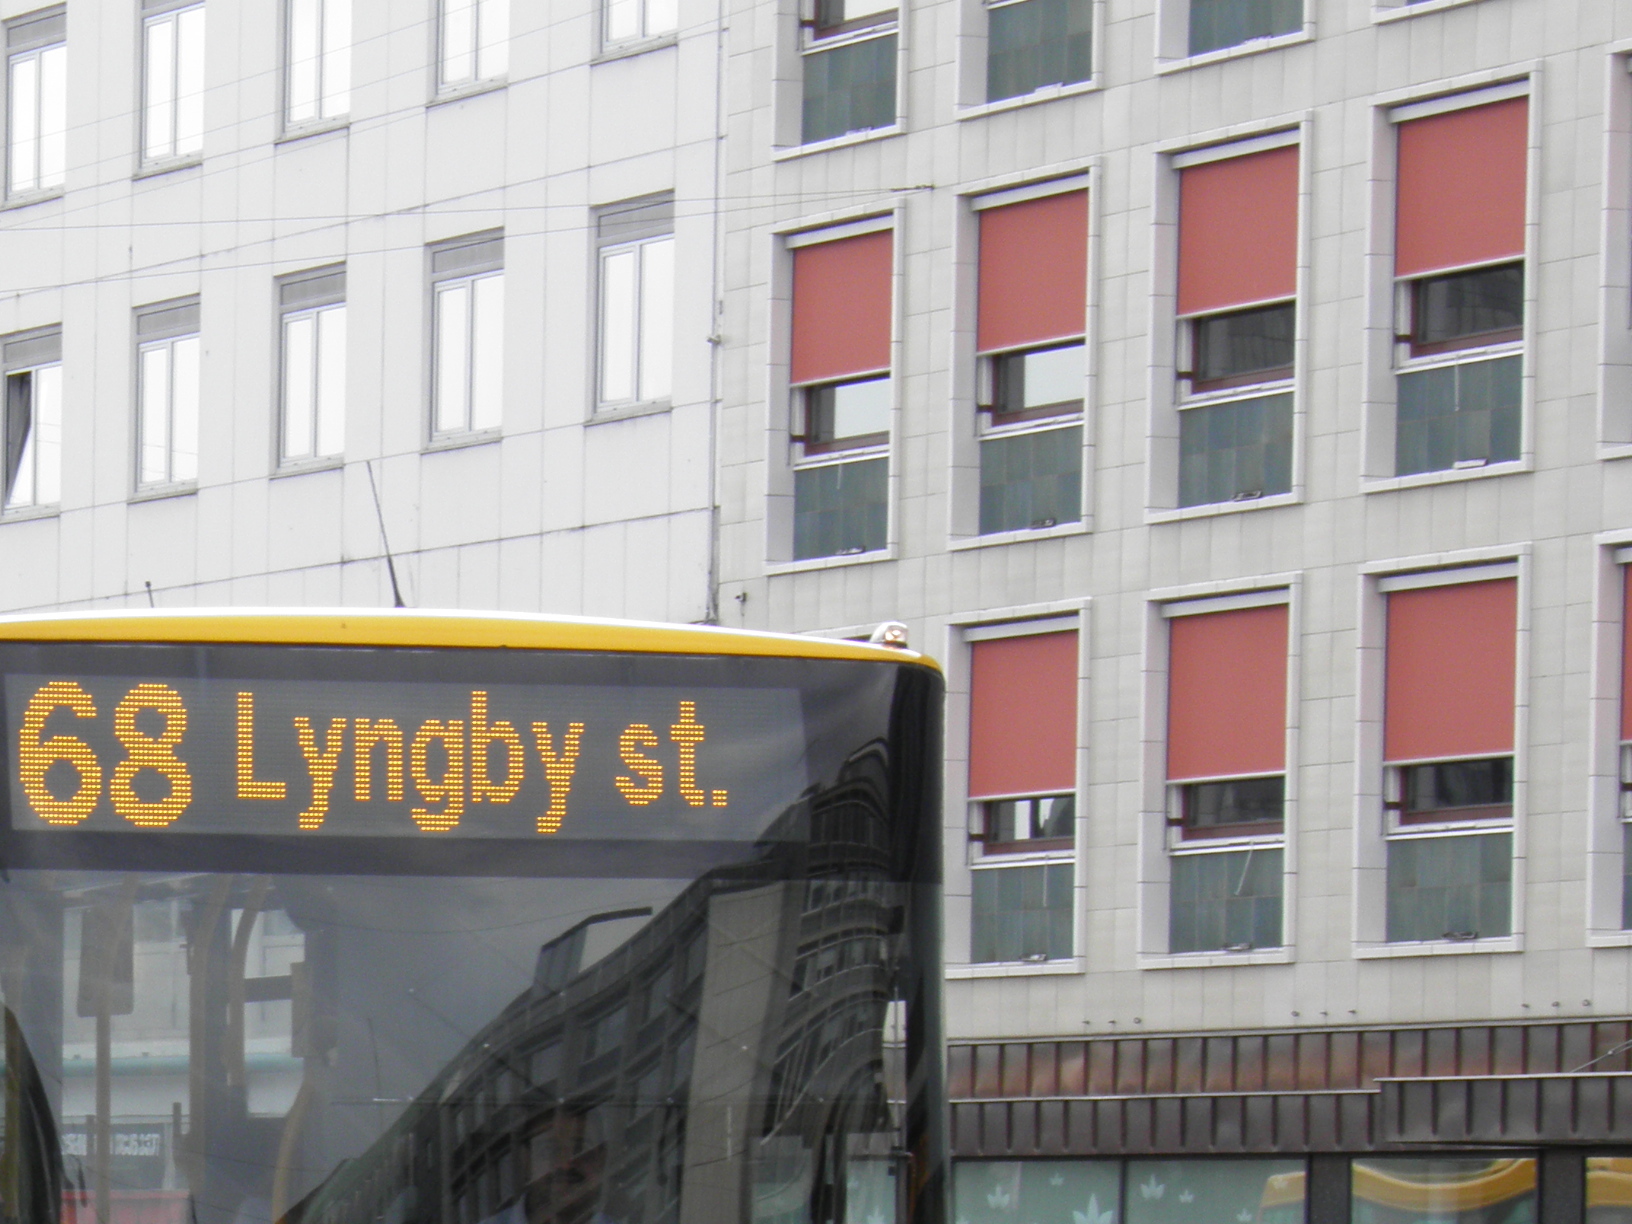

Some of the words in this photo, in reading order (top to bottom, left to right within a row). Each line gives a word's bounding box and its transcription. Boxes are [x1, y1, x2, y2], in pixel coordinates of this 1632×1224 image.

[19, 681, 192, 826] 68
[236, 691, 584, 833] Lyngby
[615, 700, 728, 806] st.
